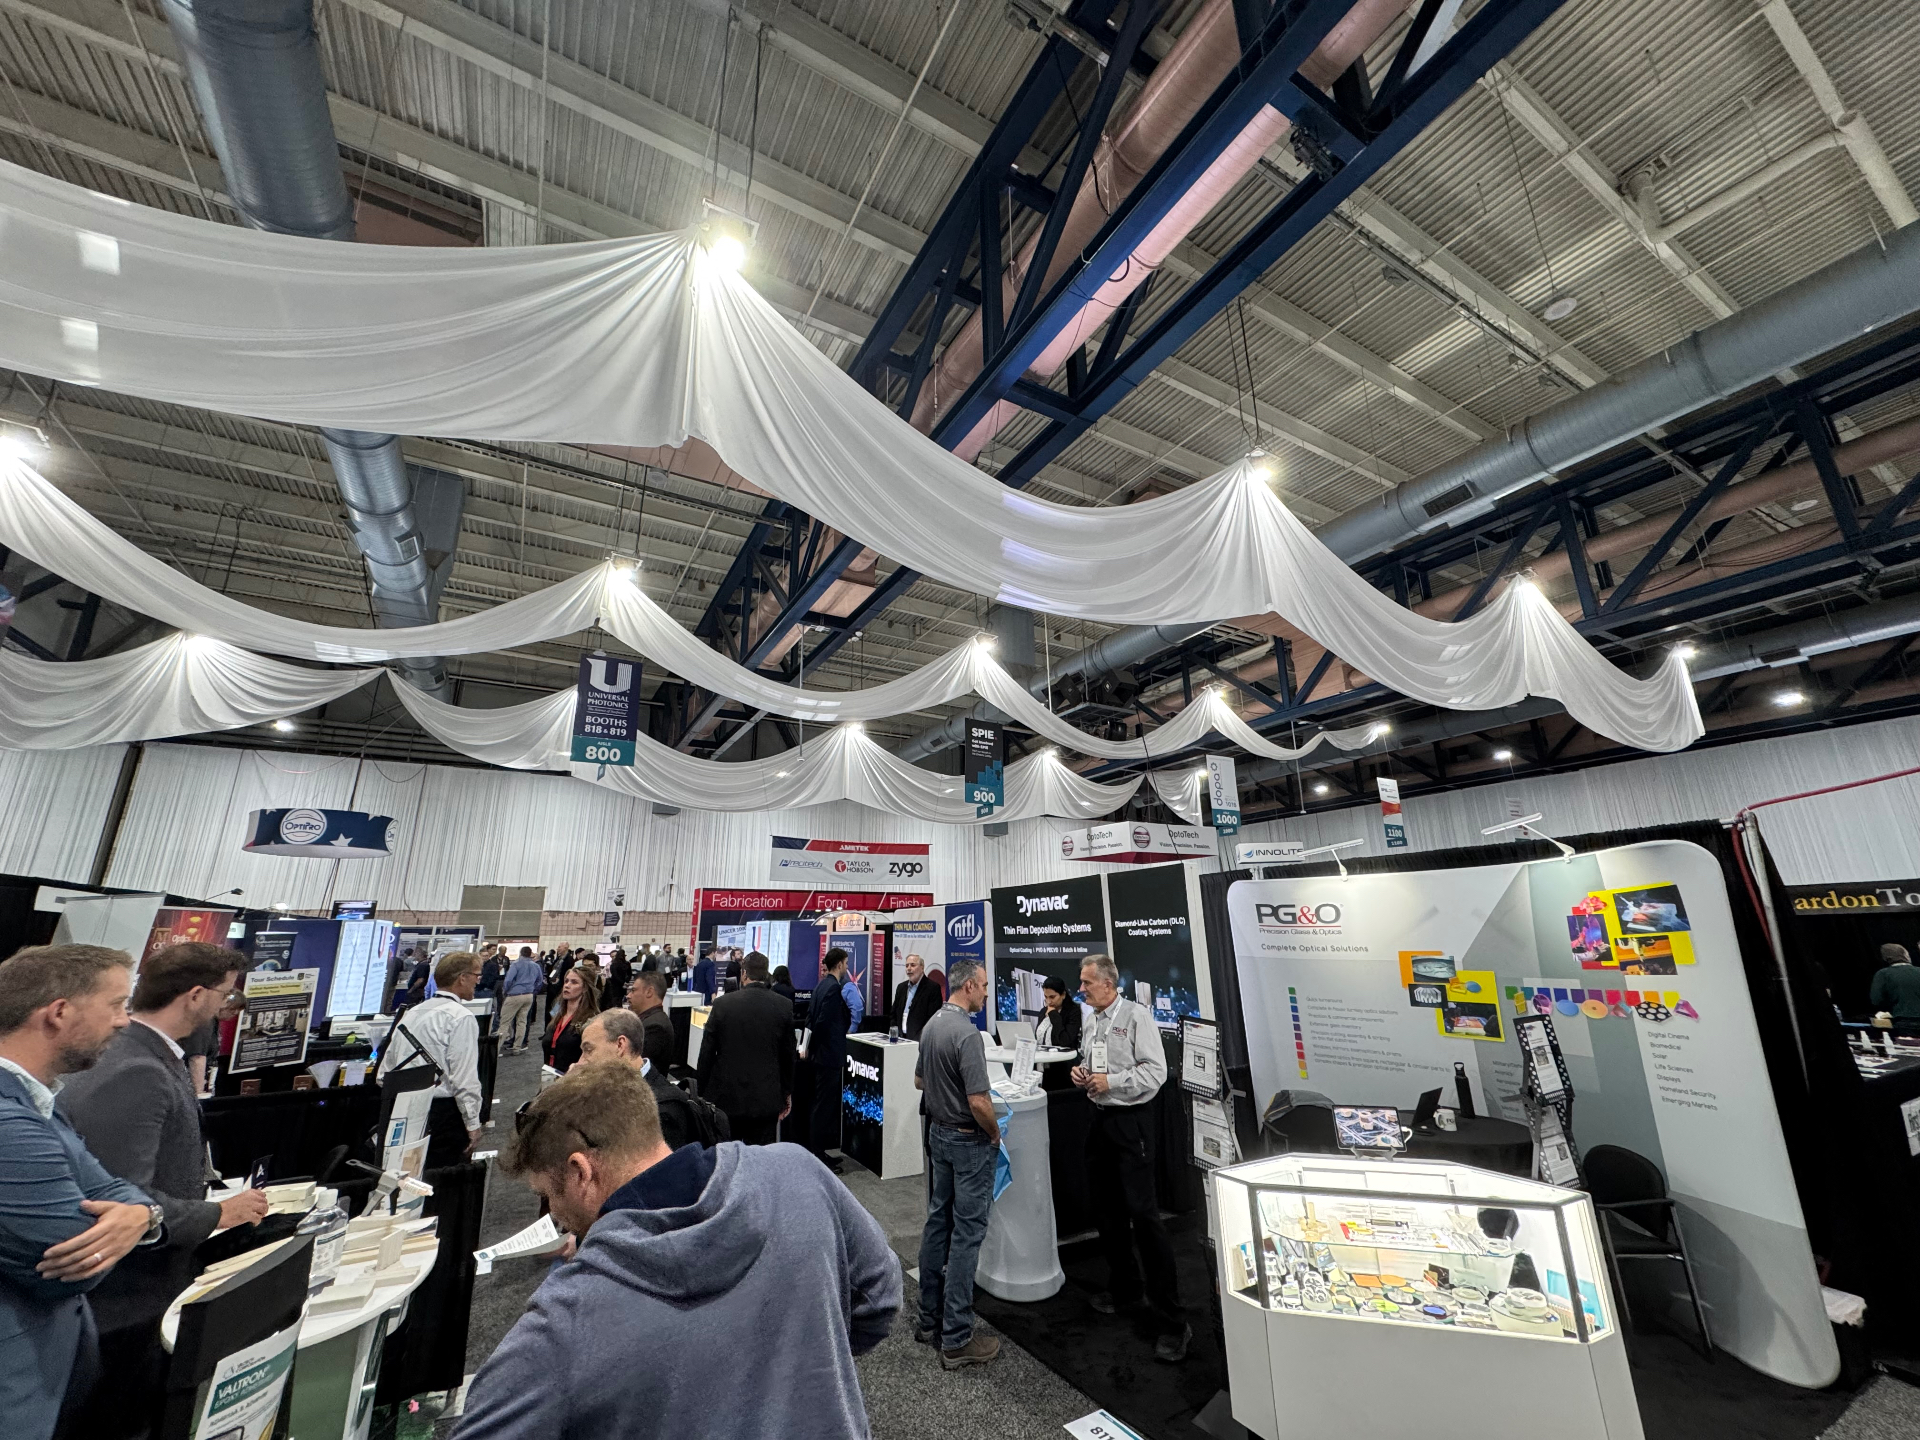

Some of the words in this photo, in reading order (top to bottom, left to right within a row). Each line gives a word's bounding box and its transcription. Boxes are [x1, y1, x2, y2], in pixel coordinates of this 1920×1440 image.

[588, 691, 630, 702] UNIVERSAL
[587, 698, 629, 709] PHOTONICS
[586, 716, 627, 727] BOOTHS
[584, 724, 602, 734] 818
[610, 728, 626, 736] 819
[585, 746, 620, 762] 800
[973, 790, 995, 803] 900
[1216, 815, 1237, 825] 1000
[1086, 831, 1113, 841] OptoTech
[1168, 830, 1200, 839] OptoTech
[1388, 829, 1402, 837] 1100
[889, 862, 923, 877] zygo
[712, 893, 783, 908] Fabrication
[817, 896, 848, 909] Form
[1016, 894, 1069, 917] Dynavac
[1255, 903, 1341, 924] PG&O
[894, 923, 903, 931] THIN
[904, 923, 912, 931] FILM
[913, 922, 934, 931] COATINGS
[954, 914, 975, 937] ntfl
[1114, 920, 1148, 928] Diamond-Like
[1149, 918, 1168, 926] Carbon
[1169, 916, 1186, 926] (DLC)
[1003, 926, 1016, 935] Thin
[1016, 926, 1029, 934] Film
[1030, 924, 1061, 936] Deposition
[1063, 923, 1091, 935] Systems
[1128, 928, 1148, 937] Coating
[1148, 928, 1171, 936] Systems
[1261, 943, 1296, 952] Complete
[1648, 1031, 1666, 1039] Digital
[1650, 1042, 1681, 1050] Biomedical
[846, 1054, 879, 1082] Dynavac
[1667, 1065, 1694, 1073] Sciences
[1656, 1074, 1681, 1083] Displays
[1659, 1085, 1688, 1095] Homeland
[1689, 1089, 1716, 1100] Security
[1661, 1096, 1691, 1107] Emerging
[1691, 1101, 1718, 1111] Markets
[218, 1368, 266, 1399] VALTRON
